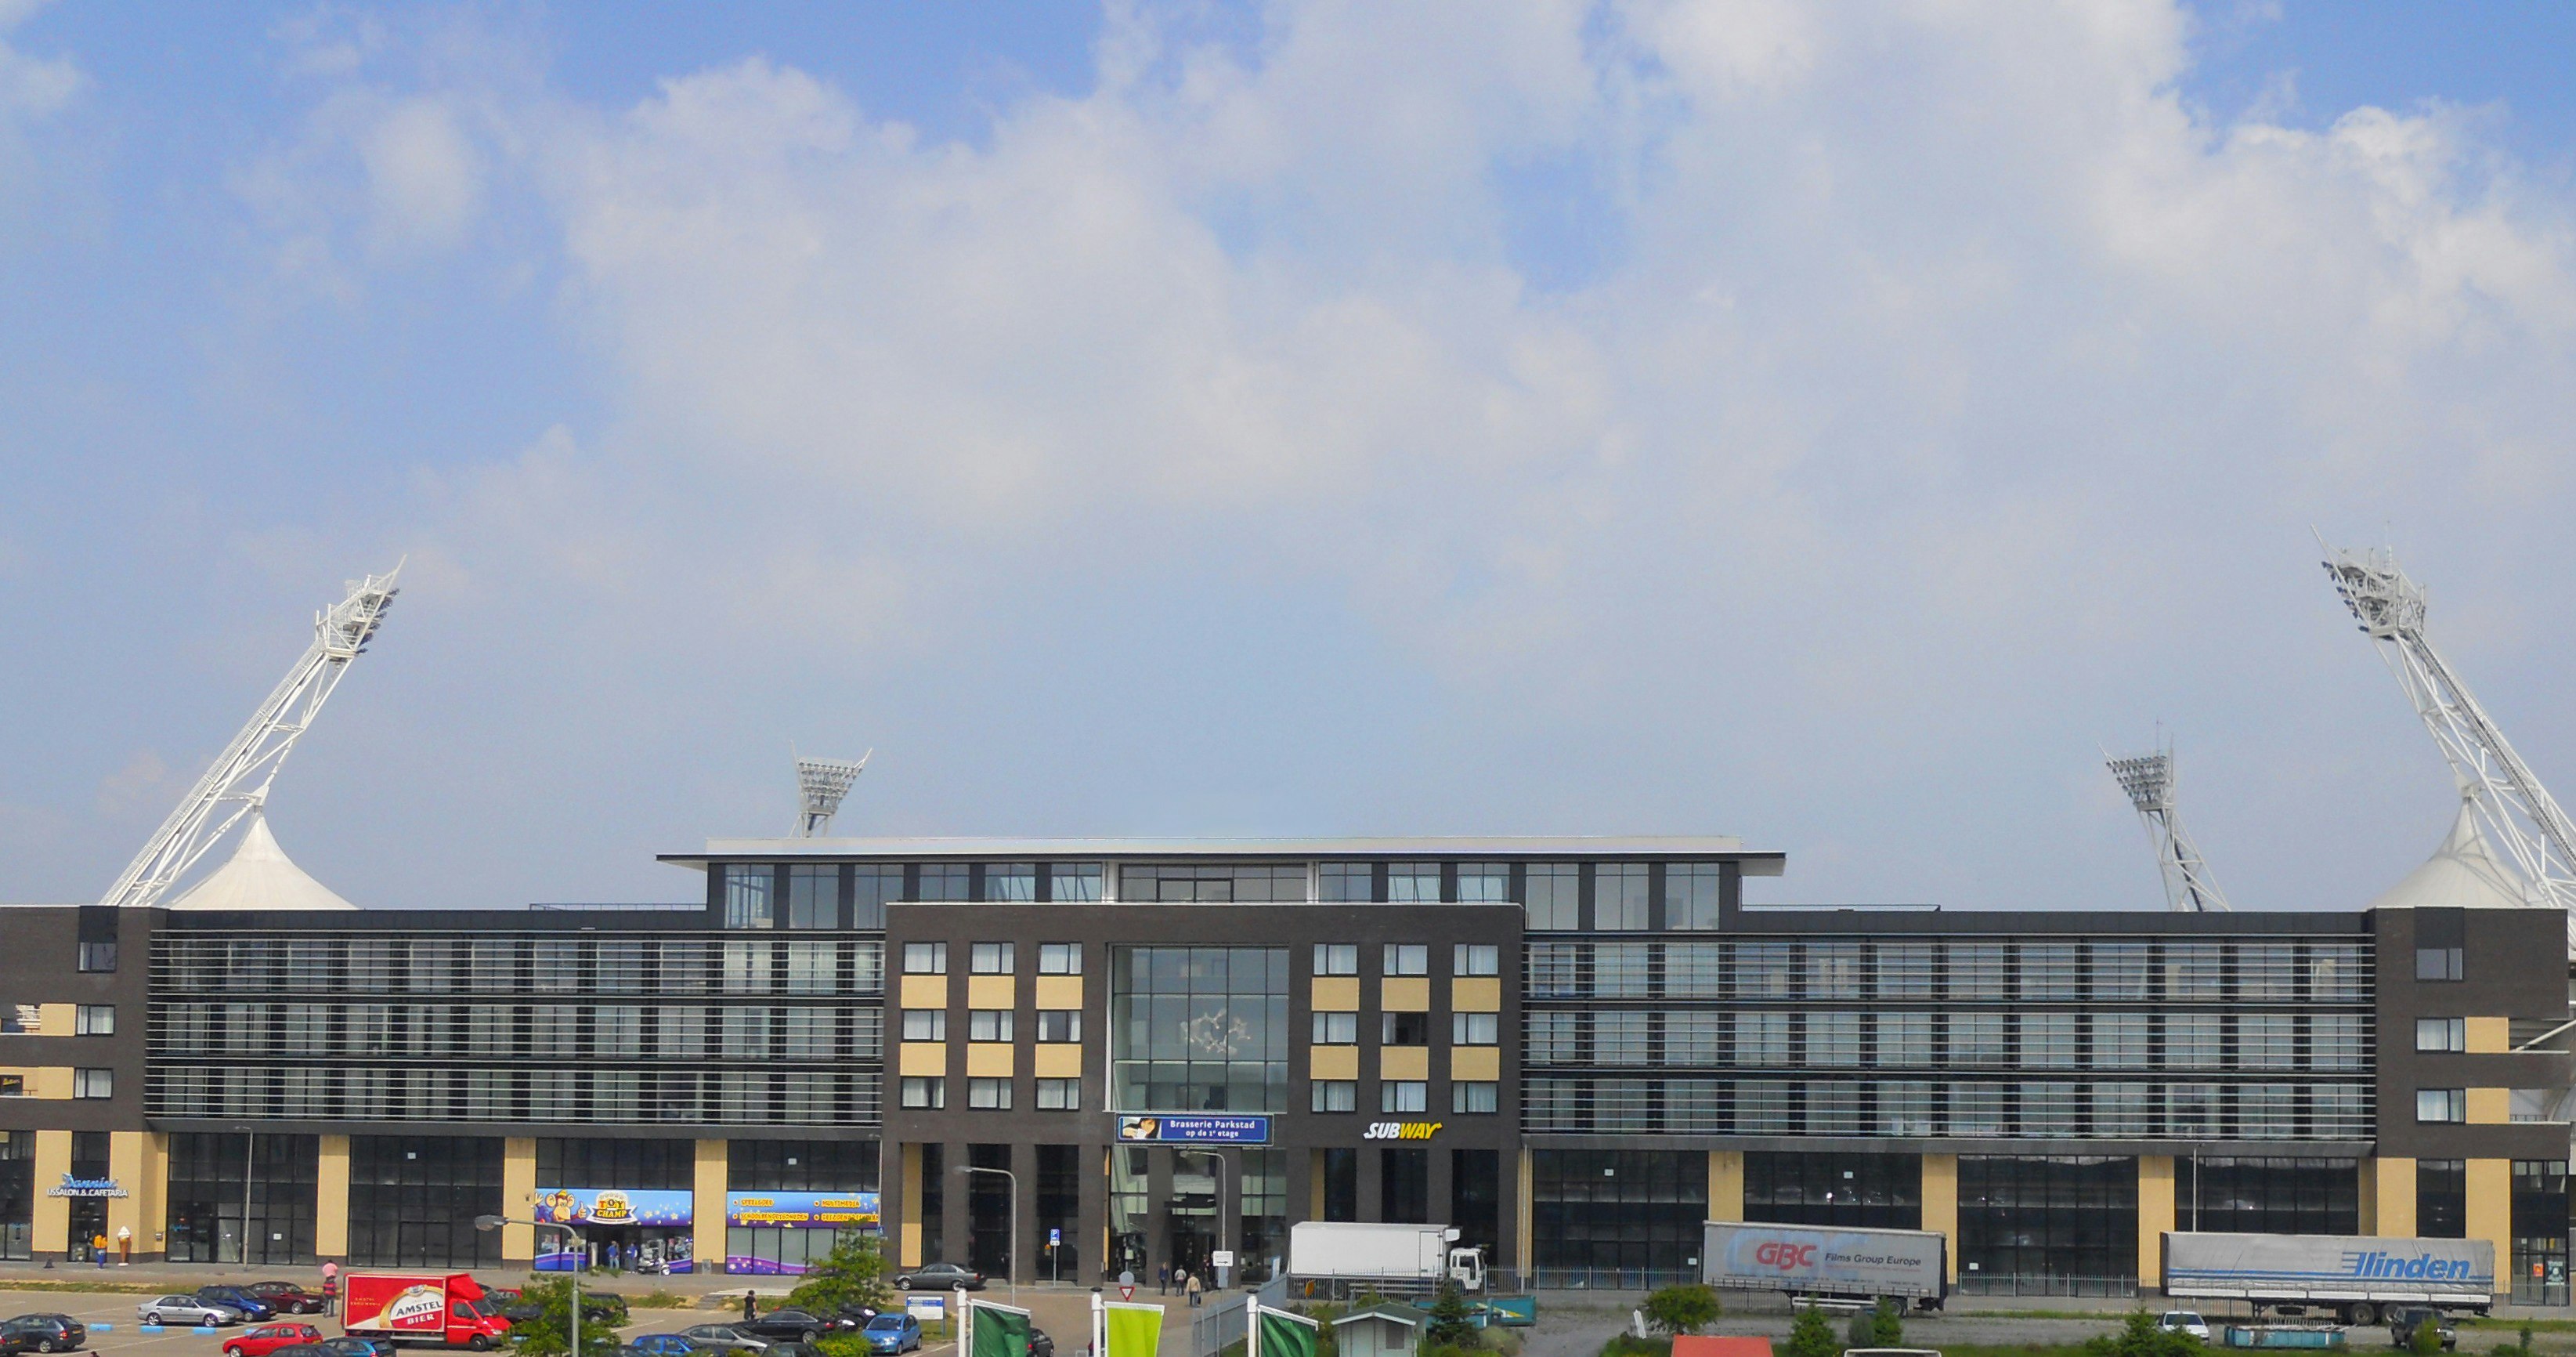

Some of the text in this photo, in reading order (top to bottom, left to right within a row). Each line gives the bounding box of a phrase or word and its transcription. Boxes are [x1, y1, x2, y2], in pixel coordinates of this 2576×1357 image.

[1363, 1122, 1443, 1139] SUBWAY
[599, 1198, 624, 1208] TOY
[596, 1210, 627, 1218] CHAMP
[1756, 1243, 1817, 1271] GBC
[1825, 1253, 1921, 1267] Films Group Europe
[396, 1301, 443, 1317] AMSTEL
[406, 1313, 435, 1325] BIER
